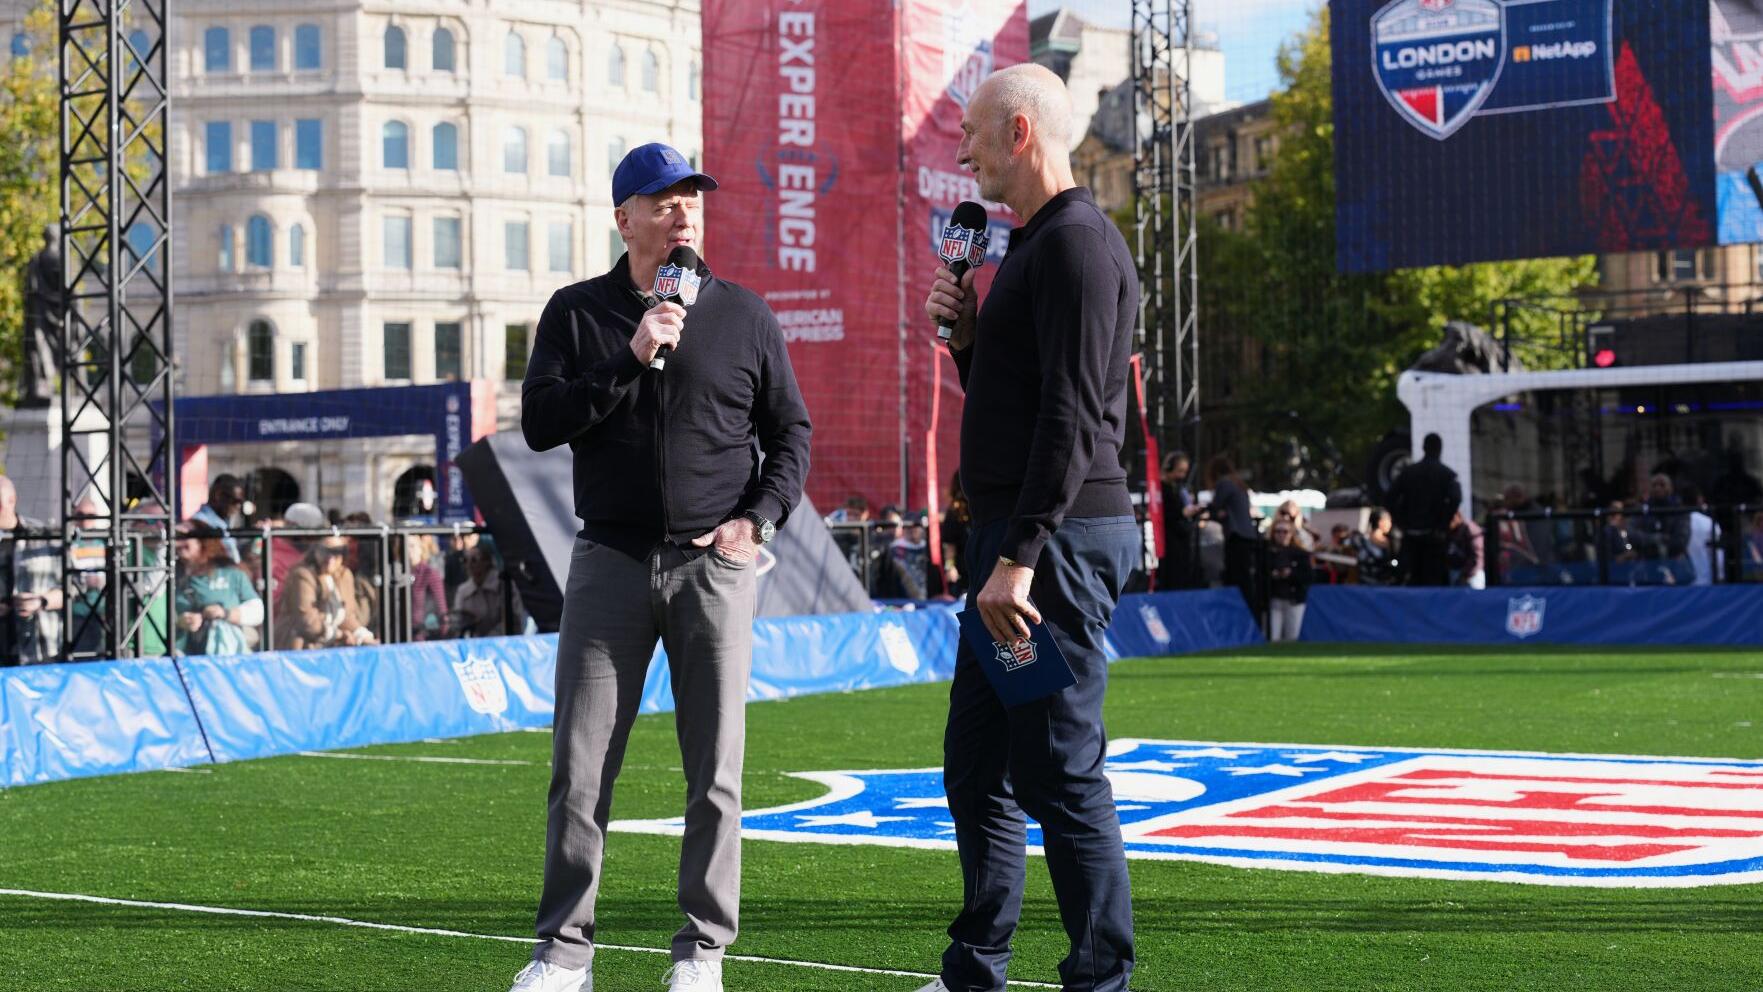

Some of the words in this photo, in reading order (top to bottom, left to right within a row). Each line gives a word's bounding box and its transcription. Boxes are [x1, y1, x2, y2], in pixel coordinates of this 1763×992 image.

[1382, 38, 1496, 70] LONDON
[1532, 41, 1597, 61] NetApp
[943, 239, 963, 257] NFL
[969, 244, 984, 264] NFL
[658, 278, 676, 293] NFL
[776, 309, 843, 325] MERICAN
[782, 324, 845, 342] XPRESS
[259, 418, 318, 435] ENTRANCE
[320, 416, 350, 432] ONLY
